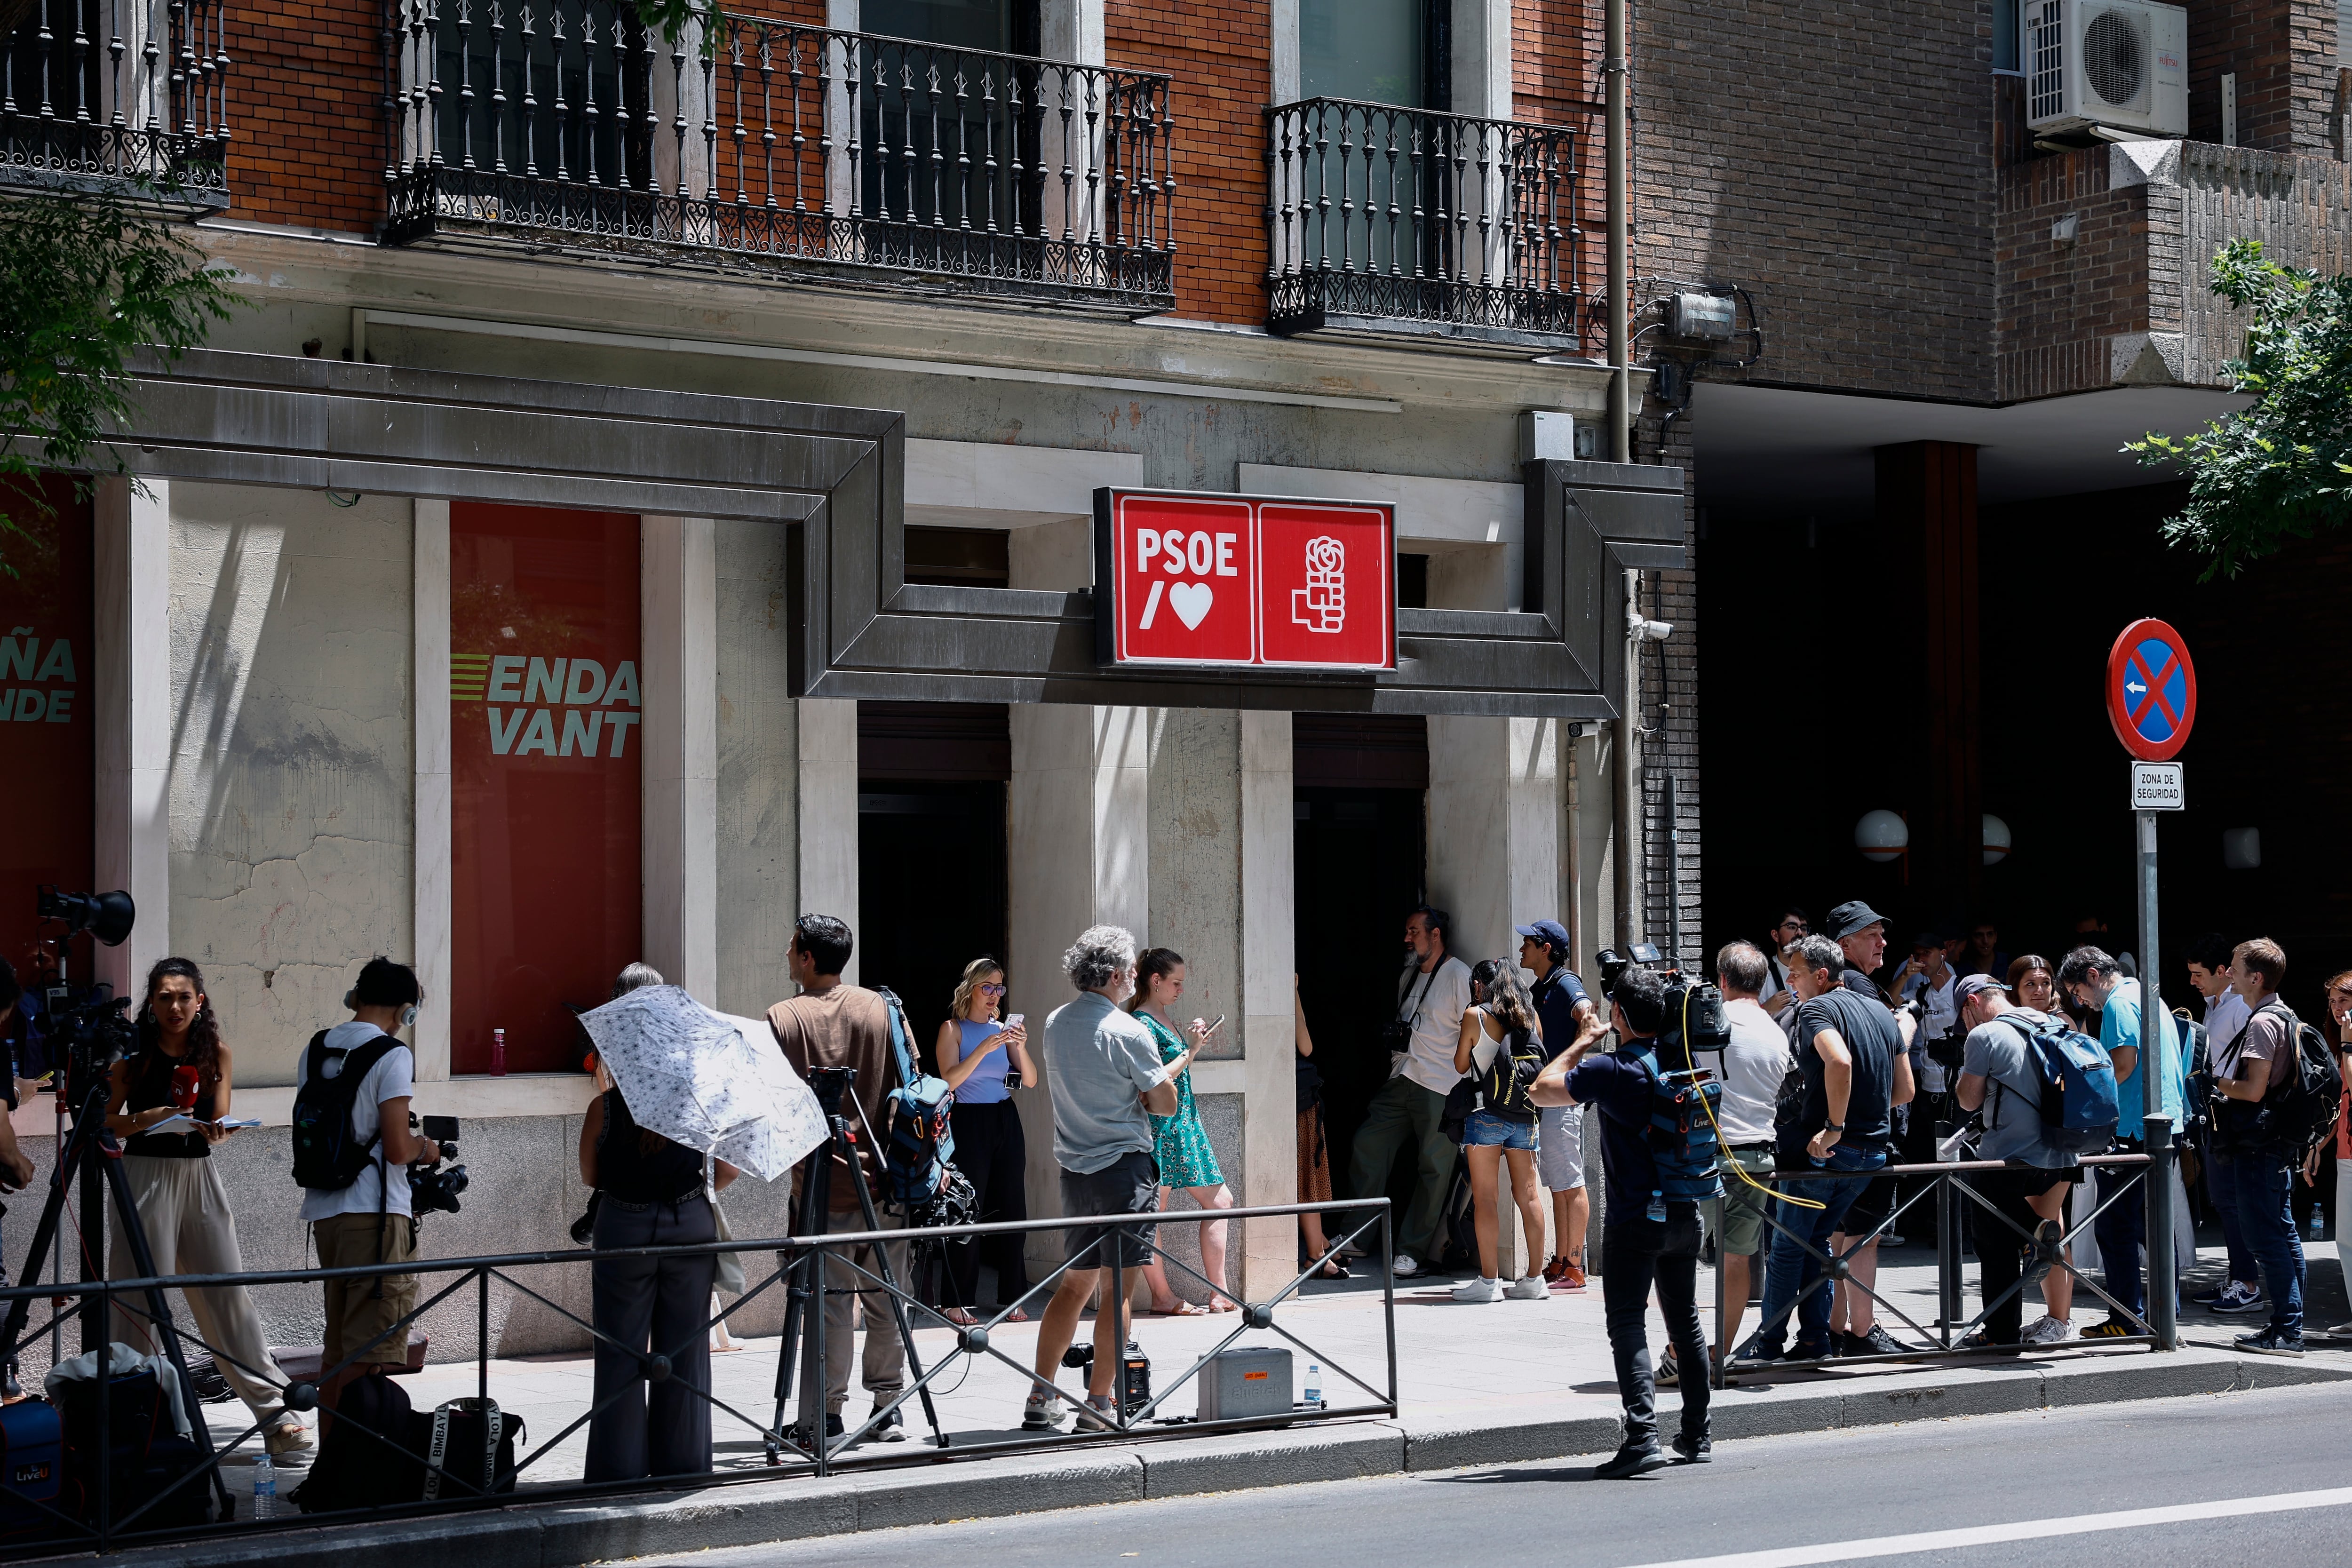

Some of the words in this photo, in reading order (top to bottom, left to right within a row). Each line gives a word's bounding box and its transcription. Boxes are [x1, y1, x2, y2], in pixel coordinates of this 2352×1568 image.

[2159, 54, 2178, 67] FUJITSU
[1137, 528, 1238, 577] PSOE
[0, 626, 77, 682] ÑA
[487, 655, 641, 706] ENDA
[487, 708, 641, 758] VANT
[2137, 788, 2178, 799] SEGURIDAD
[2142, 774, 2161, 784] ZONA
[2165, 774, 2174, 784] DE
[489, 1417, 499, 1445] LOLA
